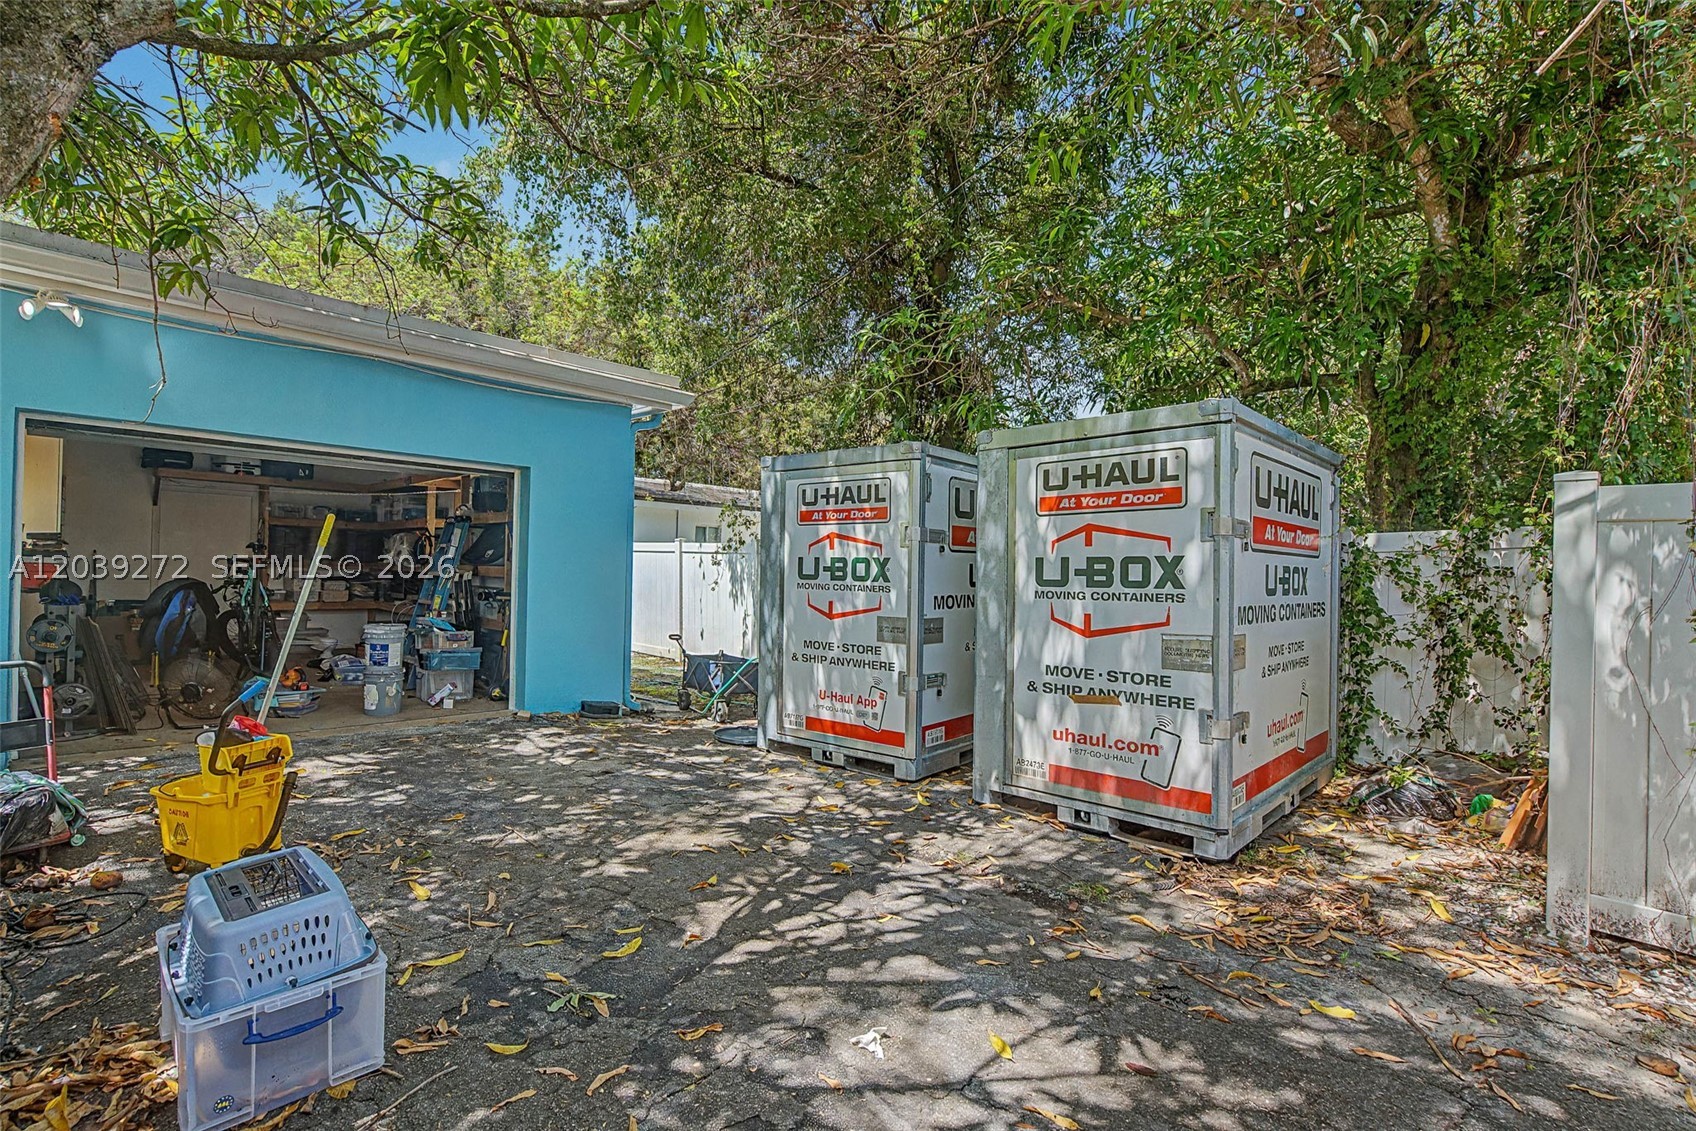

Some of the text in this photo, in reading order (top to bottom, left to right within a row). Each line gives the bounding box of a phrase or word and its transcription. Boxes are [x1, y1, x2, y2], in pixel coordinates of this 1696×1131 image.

[1043, 456, 1180, 491] U-HAUL
[802, 484, 886, 506] U-HAUL
[1059, 493, 1164, 508] At Your Door
[1255, 466, 1319, 521] U-HAUL
[825, 511, 848, 519] Your
[850, 510, 877, 518] Door
[1264, 524, 1315, 547] At Your Door
[797, 556, 891, 583] U-BOX
[796, 582, 891, 594] MOVING CONTAINERS
[1265, 564, 1308, 597] U-BOX
[933, 594, 975, 611] MOVIN
[1034, 590, 1186, 603] MOVING CONTAINERS
[1237, 601, 1326, 626] MOVING CONTAINERS
[803, 640, 882, 655] MOVE STORE
[1268, 640, 1305, 658] MOVE STORE
[791, 652, 896, 672] & SHIP ANYWHERE
[1261, 656, 1309, 679] & SHIP ANYWHERE
[1045, 664, 1172, 688] MOVE STORE
[1026, 680, 1038, 692] &
[1042, 681, 1082, 696] SHIP
[819, 689, 853, 704] U-Haul
[856, 695, 878, 709] App
[1267, 710, 1304, 738] uhaul.com
[1052, 728, 1160, 757] uhaul.com
[1016, 758, 1045, 770] AB2473E
[1068, 747, 1135, 764] 1-877-GO-U-HAUL
